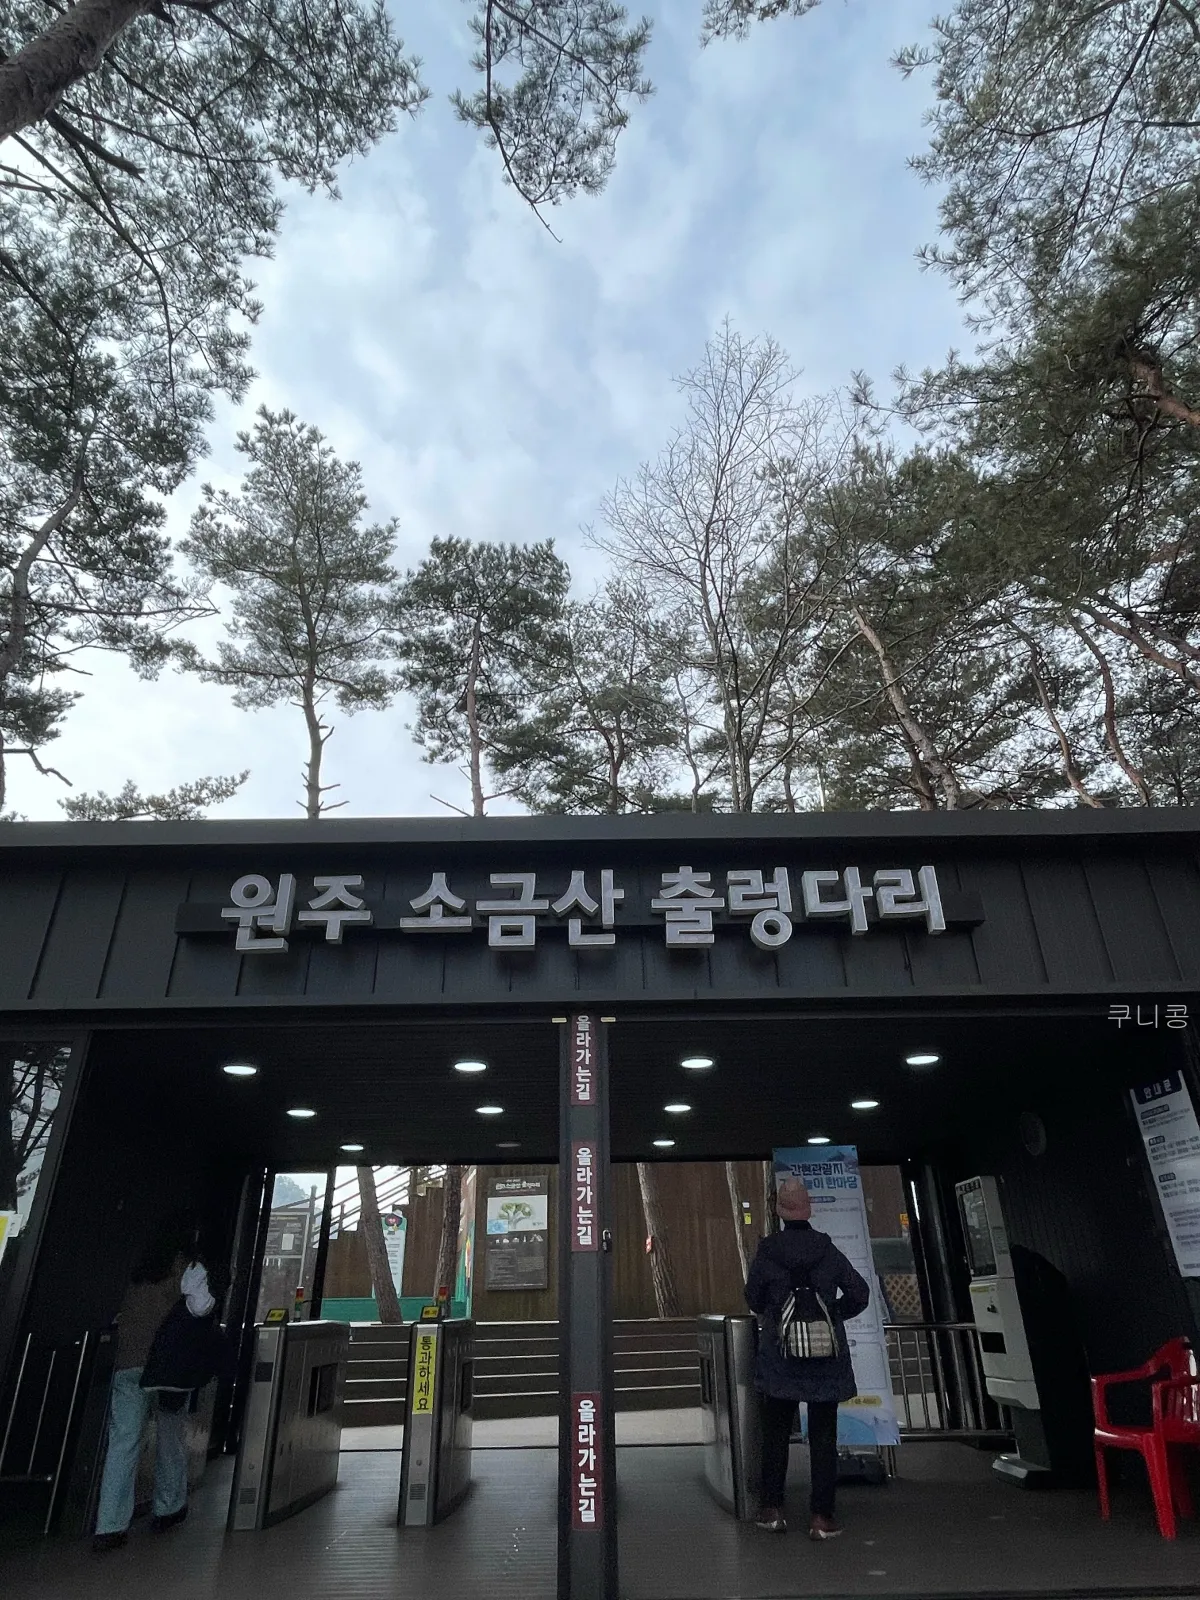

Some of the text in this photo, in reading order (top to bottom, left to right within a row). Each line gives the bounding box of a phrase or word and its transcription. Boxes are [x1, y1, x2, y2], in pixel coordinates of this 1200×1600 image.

[221, 865, 946, 953] 원주 소금산 출렁다리
[576, 1015, 592, 1100] 올라가는길
[576, 1147, 593, 1245] 올라가는길
[790, 1163, 844, 1176] 간현관광지
[826, 1176, 858, 1189] 한마당
[416, 1336, 433, 1411] 통과하세요
[578, 1400, 597, 1523] 올라가는길
